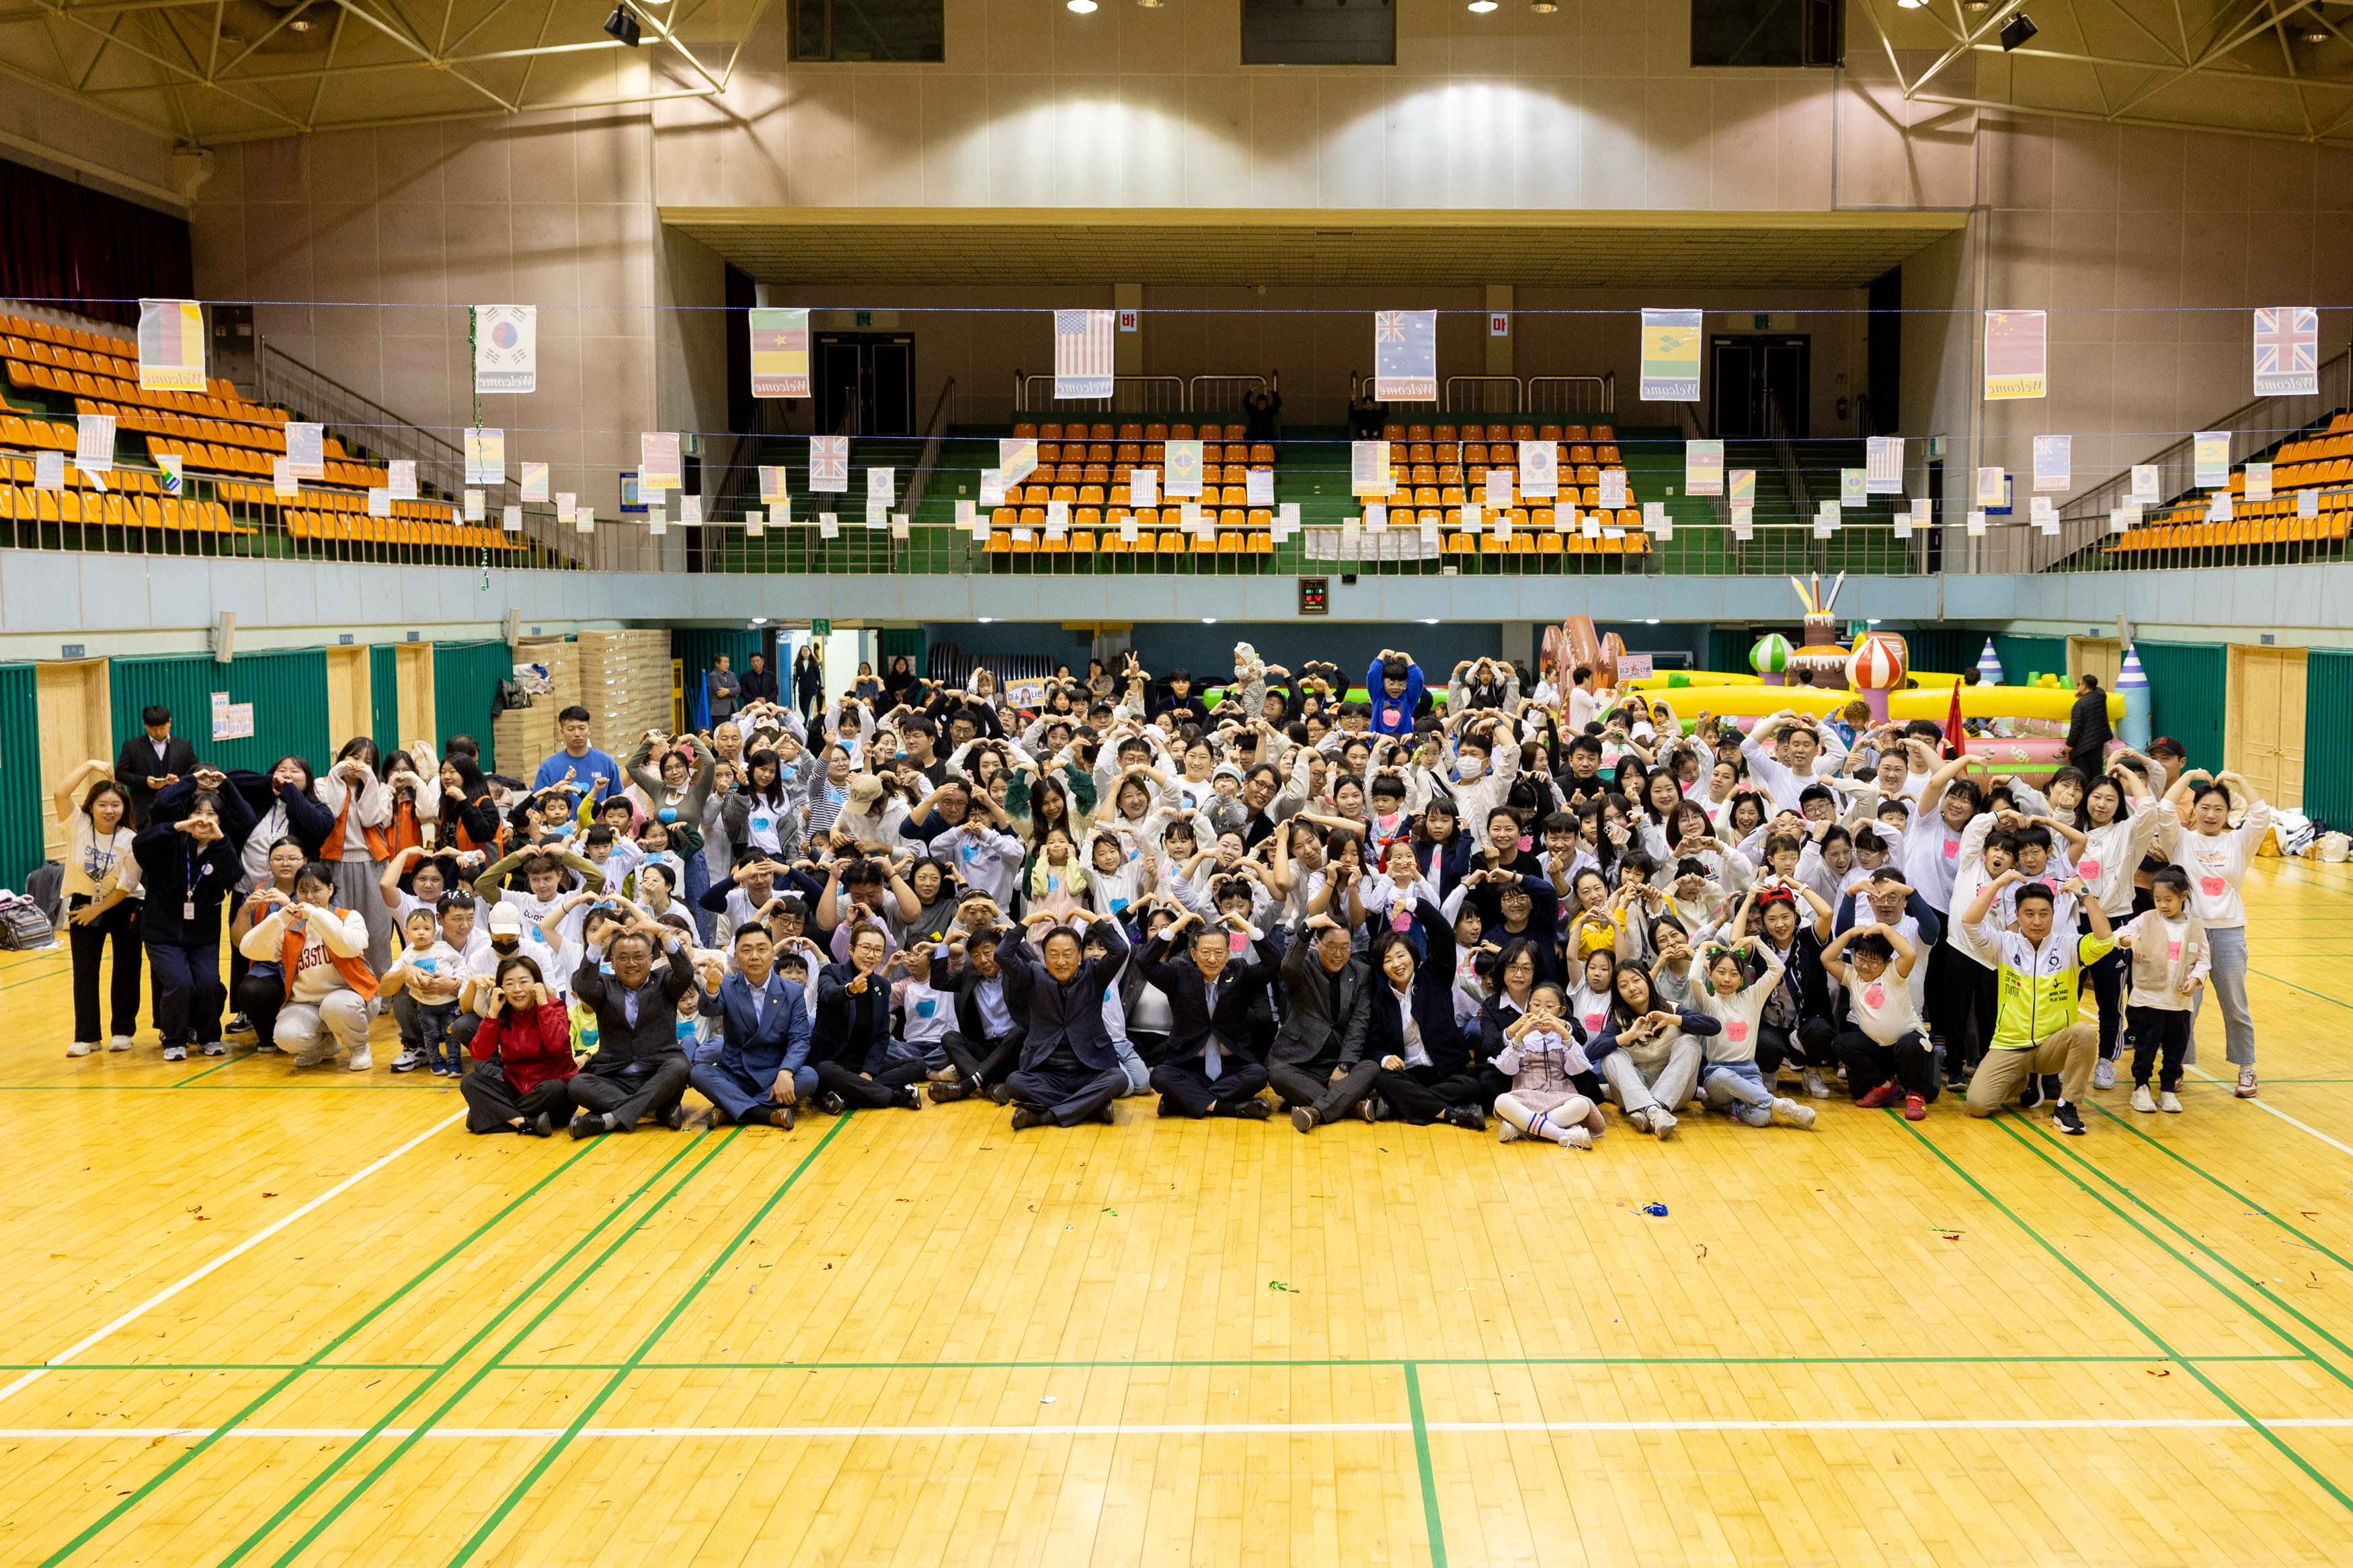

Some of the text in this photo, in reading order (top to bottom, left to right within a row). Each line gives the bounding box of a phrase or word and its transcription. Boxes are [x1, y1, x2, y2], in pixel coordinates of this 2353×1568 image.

[1122, 313, 1135, 328] 바
[1493, 318, 1506, 332] 마
[1008, 693, 1020, 701] 미소
[2202, 882, 2219, 891] 여림
[2006, 970, 2022, 981] SENTIDO
